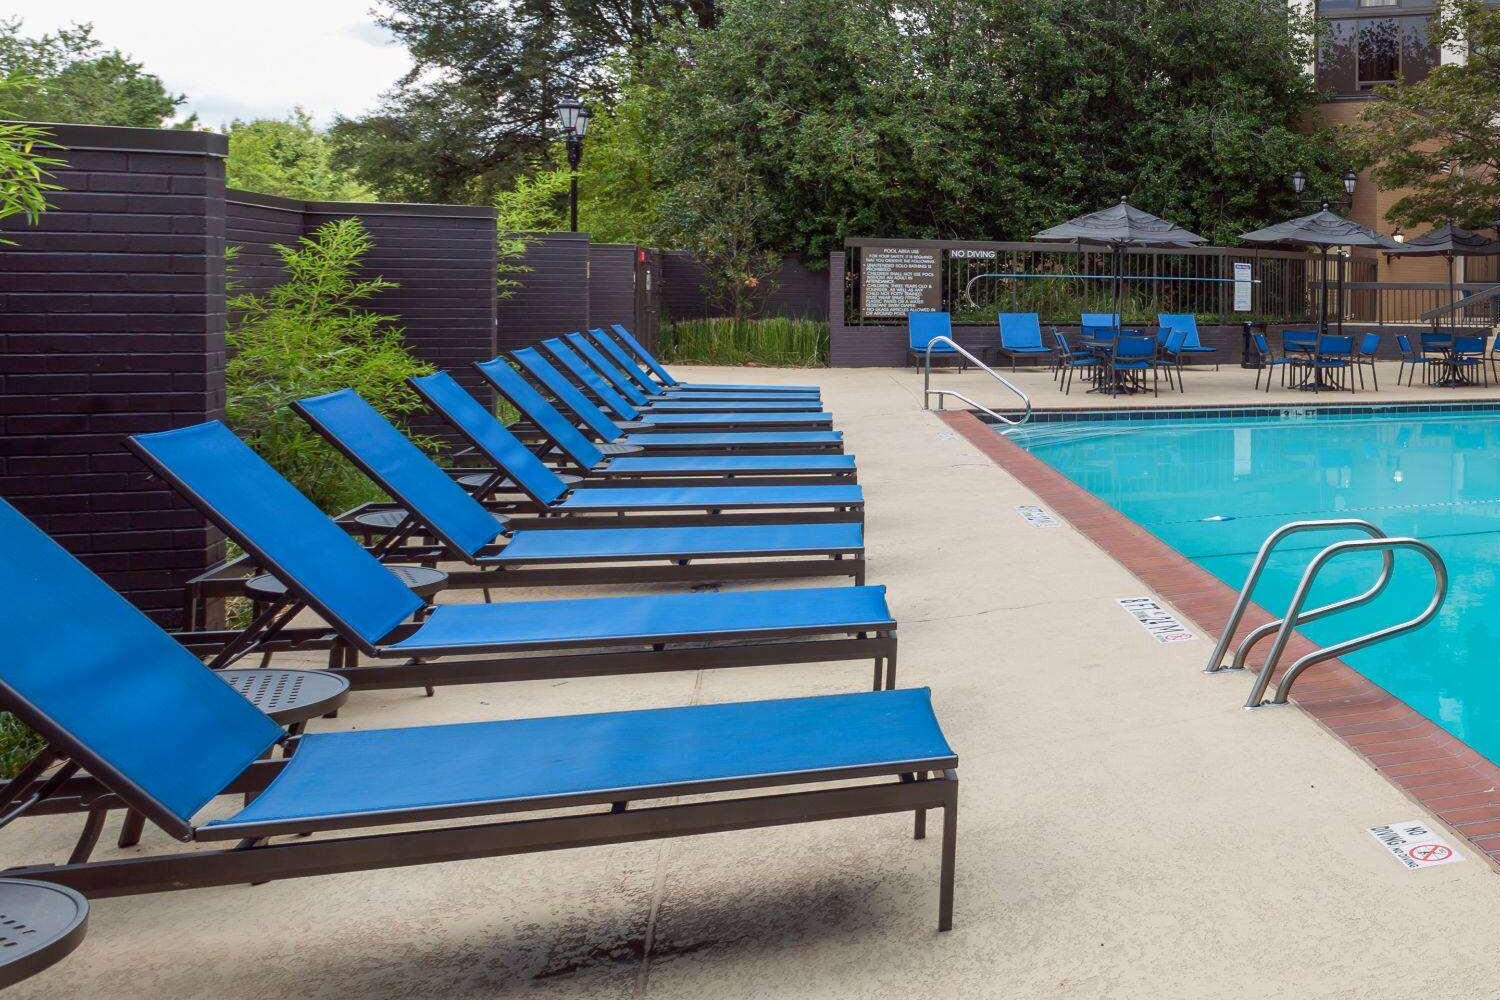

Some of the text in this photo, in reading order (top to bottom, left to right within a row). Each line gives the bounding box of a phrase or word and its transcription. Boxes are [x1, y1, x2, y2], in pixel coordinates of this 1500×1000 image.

[951, 250, 996, 259] NO DIVING
[1404, 826, 1428, 836] NO
